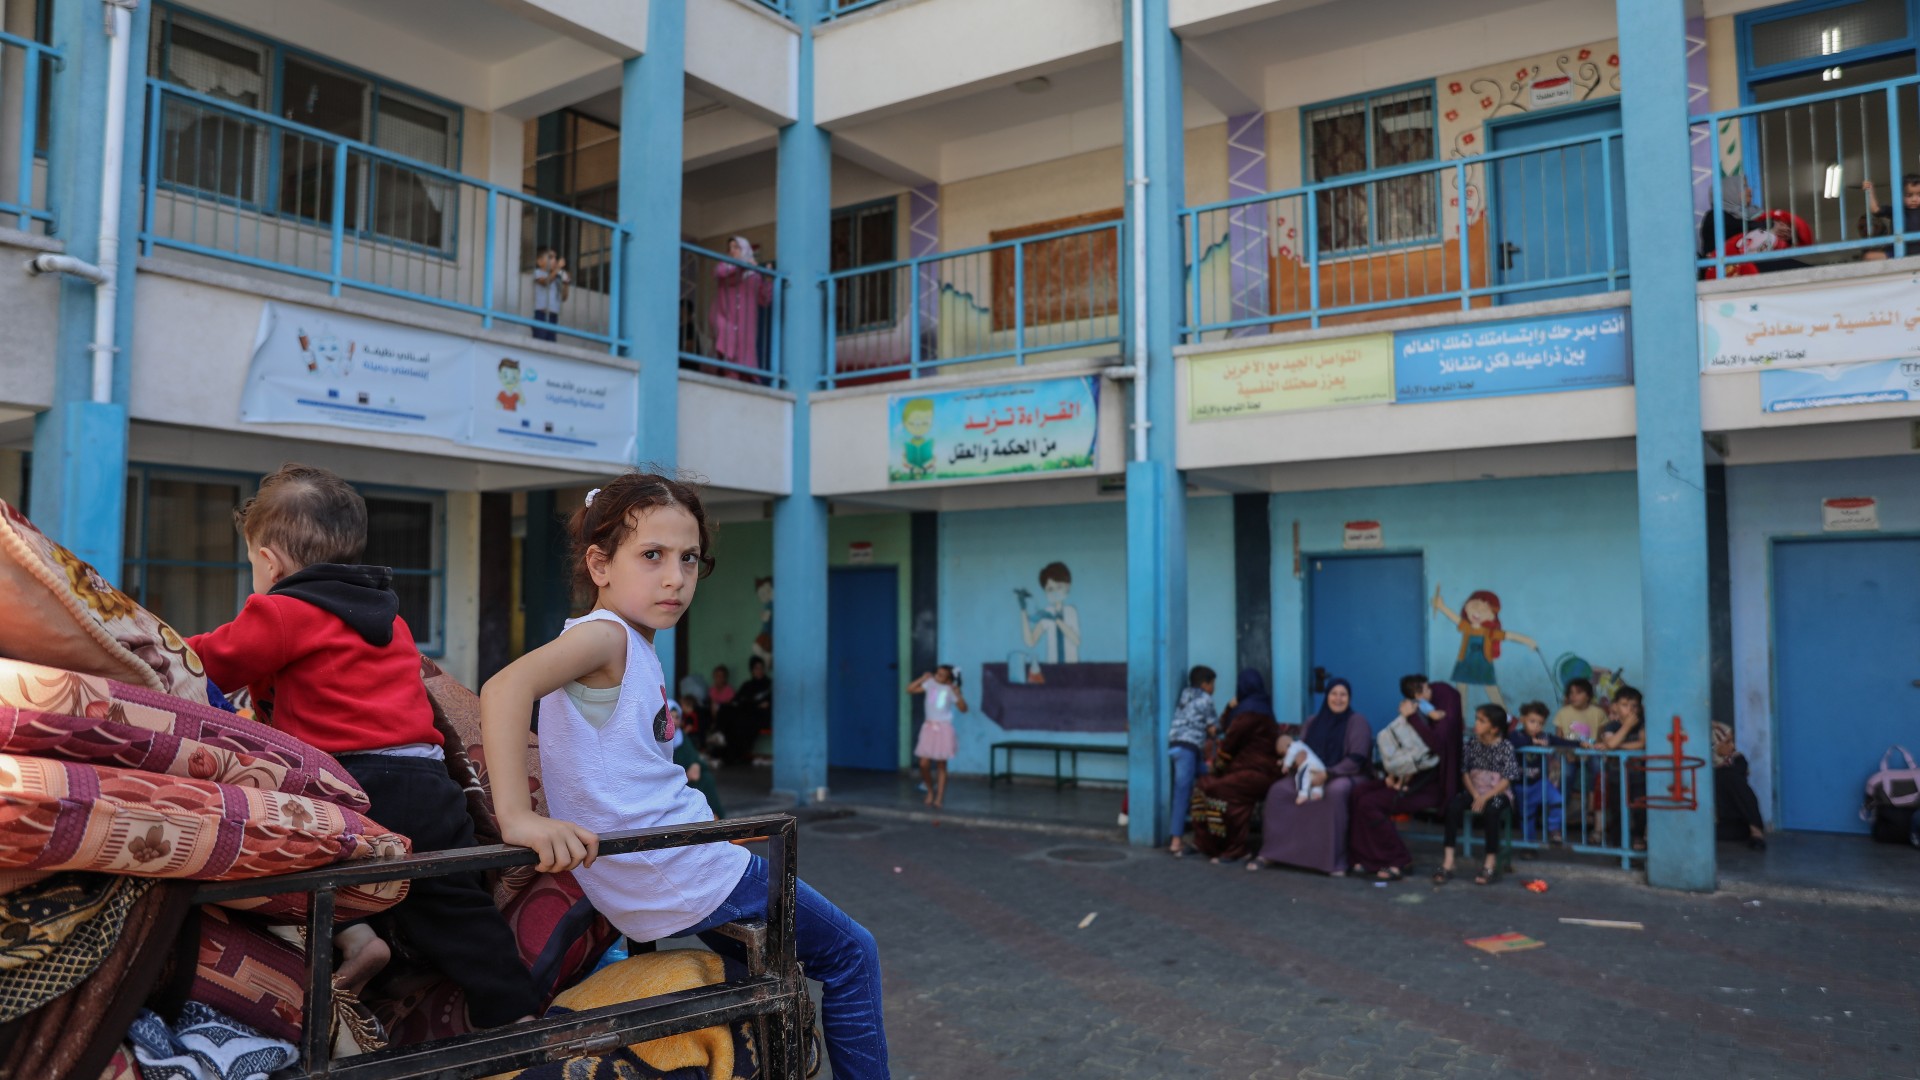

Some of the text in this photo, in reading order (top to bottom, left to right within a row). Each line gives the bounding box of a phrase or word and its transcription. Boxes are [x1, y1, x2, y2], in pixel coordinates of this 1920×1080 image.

[1807, 322, 1830, 337] سر
[1833, 311, 1899, 333] النفسية
[1402, 315, 1625, 358] أنت بمرحك وابتسامتك تملك العالم
[1745, 321, 1804, 345] سعادتي
[1282, 355, 1313, 373] الجيد
[1315, 350, 1362, 369] التواصل
[1485, 352, 1510, 373] فكن
[1512, 347, 1561, 369] ذراعيك
[1563, 347, 1586, 366] بين
[1748, 352, 1783, 365] التوجيه
[1784, 349, 1807, 361] لجنة
[1267, 362, 1280, 376] مع
[1237, 380, 1279, 399] النفسية
[1428, 383, 1456, 395] التوجيه
[1457, 380, 1474, 390] لجنة
[1222, 403, 1246, 414] التوجيه
[1246, 401, 1261, 410] لجنة
[964, 400, 1080, 435] القراءة تزيد
[949, 438, 1056, 465] من الحكمة والعقل
